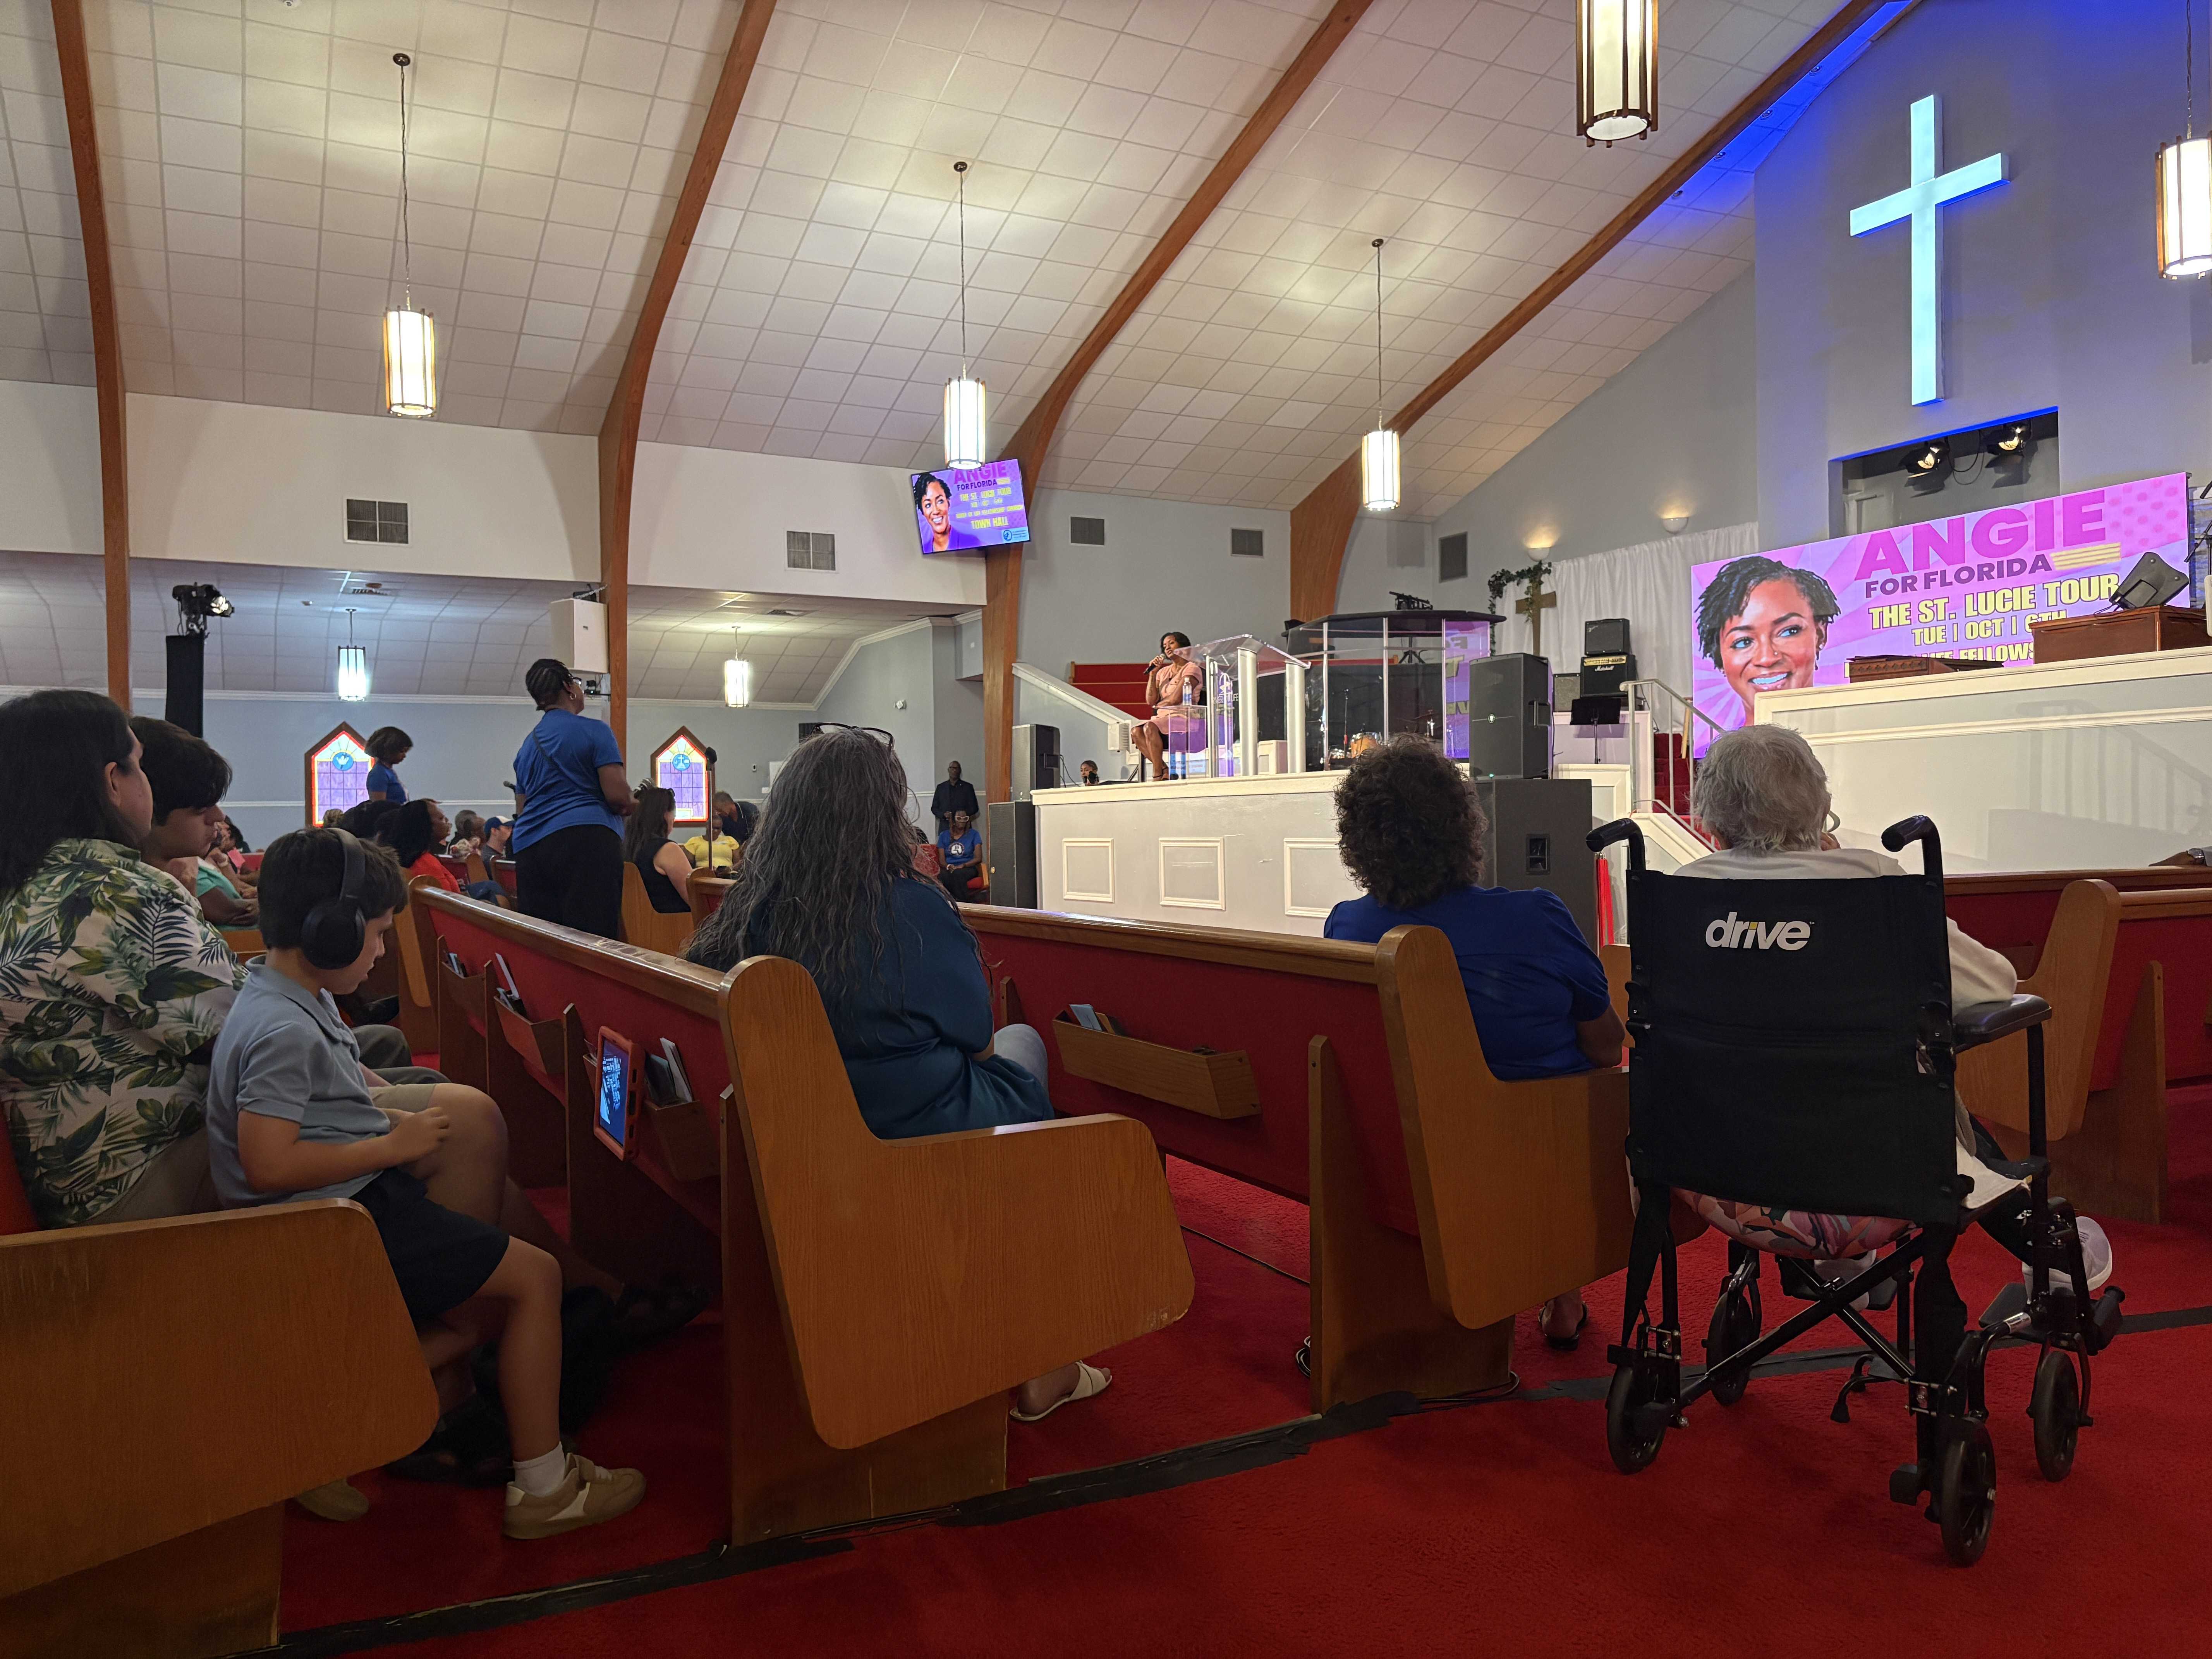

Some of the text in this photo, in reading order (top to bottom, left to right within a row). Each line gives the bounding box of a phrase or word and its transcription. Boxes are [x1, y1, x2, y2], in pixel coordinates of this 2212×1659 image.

[954, 462, 1007, 484] ANGIE
[970, 479, 997, 489] FLORIDA
[1854, 490, 2106, 580] ANGIE
[1865, 554, 2053, 598] FOR FLORIDA
[1868, 573, 2119, 630] THE ST. LUCIE TOUR
[1911, 625, 1947, 646] TUE
[1965, 618, 2004, 640] OCT
[1705, 912, 1810, 950] drive
